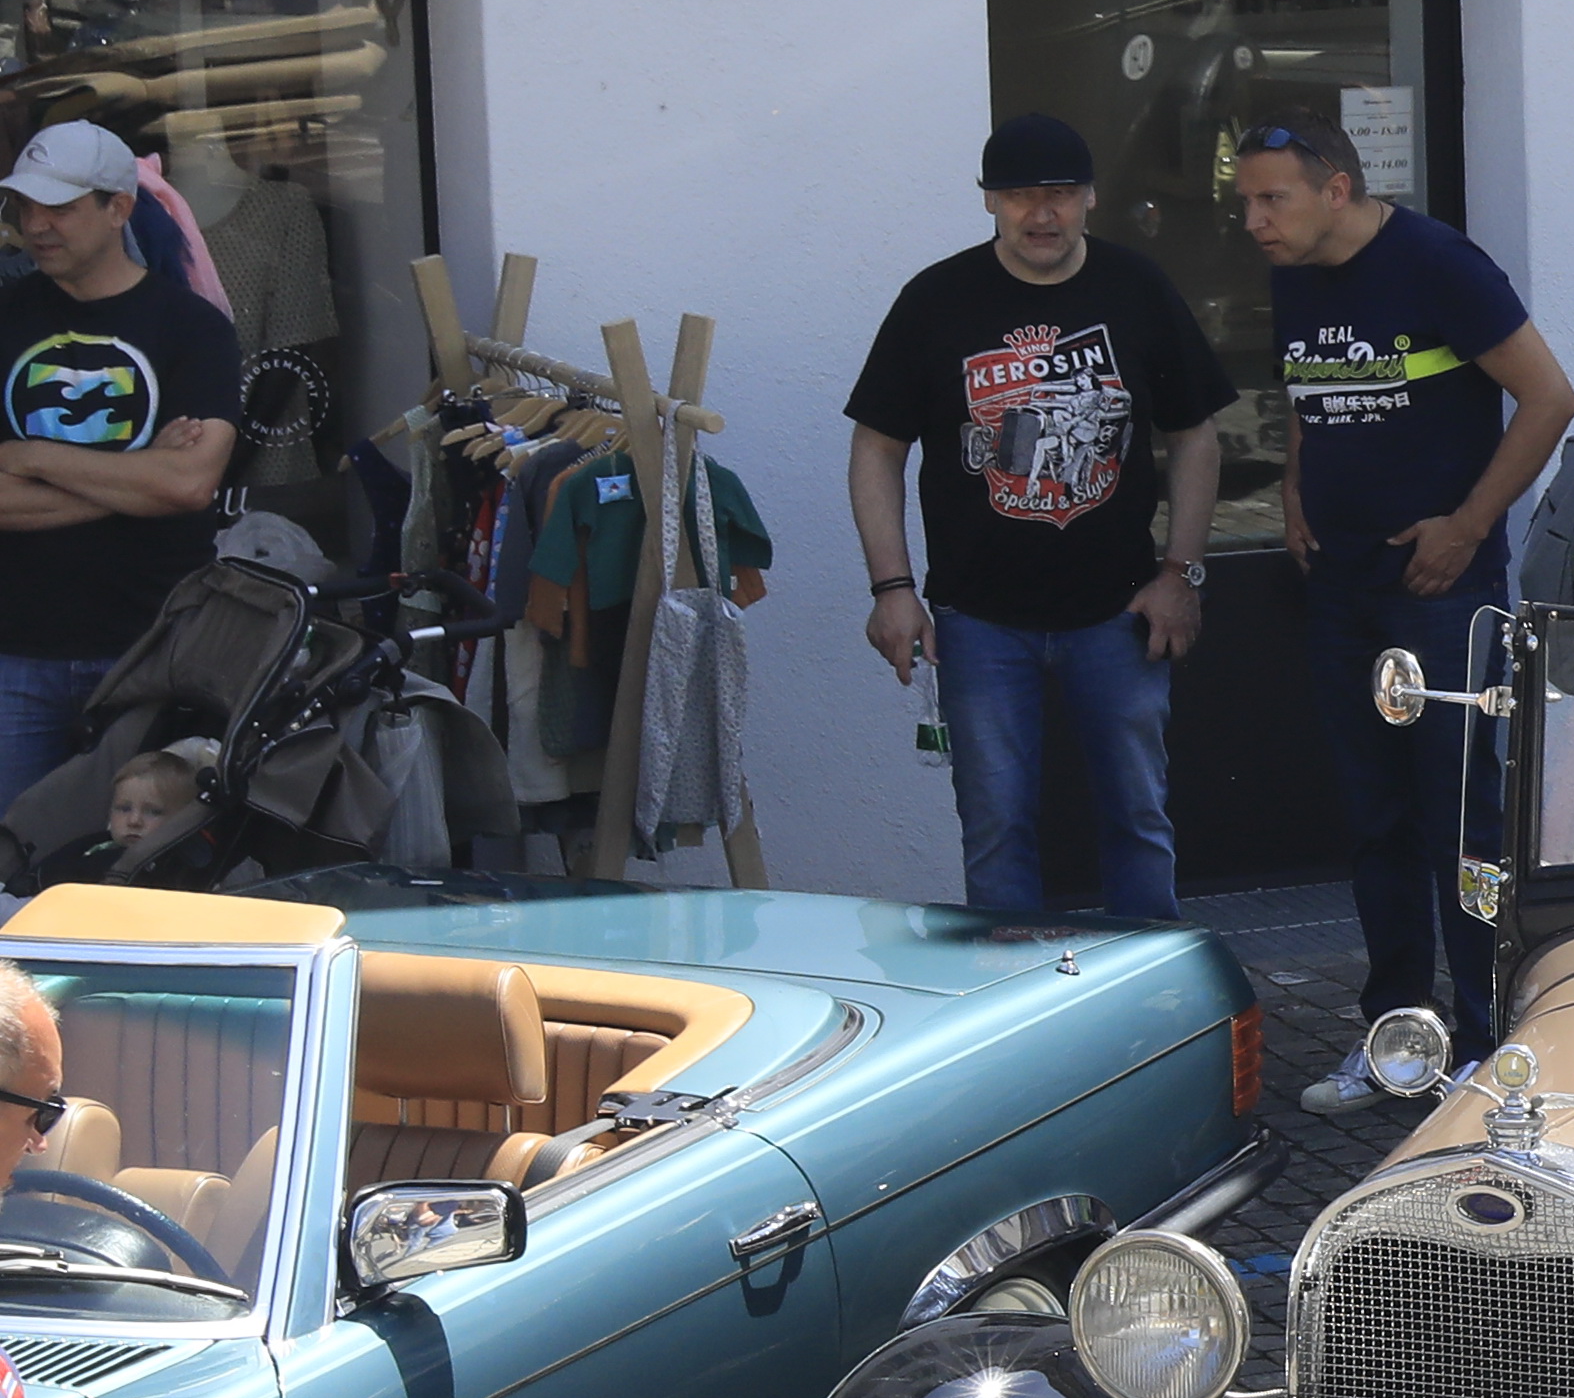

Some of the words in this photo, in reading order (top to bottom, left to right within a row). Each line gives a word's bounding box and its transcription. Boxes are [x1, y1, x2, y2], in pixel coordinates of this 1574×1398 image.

[1018, 342, 1050, 356] KING
[1318, 325, 1355, 345] REAL
[973, 345, 1105, 389] KEROSIN
[994, 485, 1056, 511] Speed
[1058, 496, 1071, 509] &
[1073, 468, 1115, 504] Style
